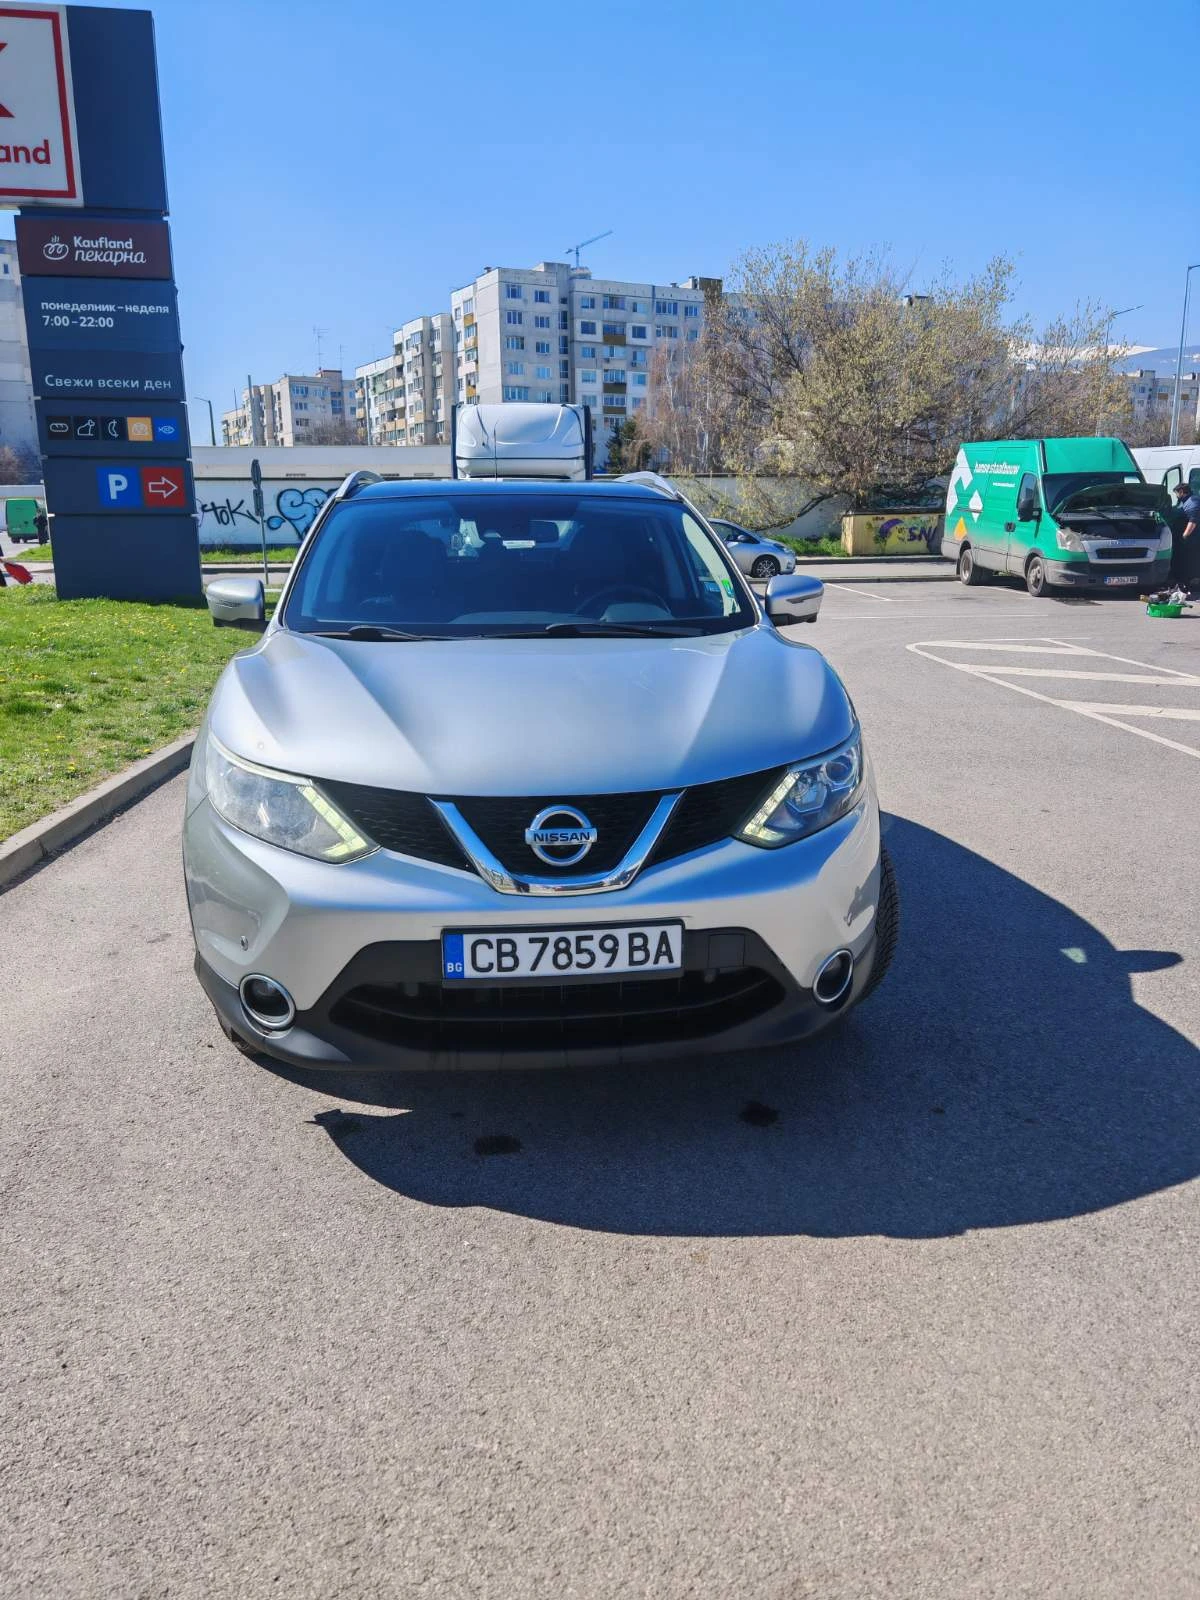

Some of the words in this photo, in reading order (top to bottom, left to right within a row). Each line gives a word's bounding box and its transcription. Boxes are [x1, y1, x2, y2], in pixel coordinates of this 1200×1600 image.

[73, 235, 133, 249] Kaufland
[74, 249, 147, 266] пекарна
[45, 375, 93, 388] Свежи
[98, 378, 139, 389] всеки
[144, 379, 171, 391] ден
[108, 474, 128, 500] P
[533, 832, 590, 842] NISSAN
[447, 962, 463, 973] BG
